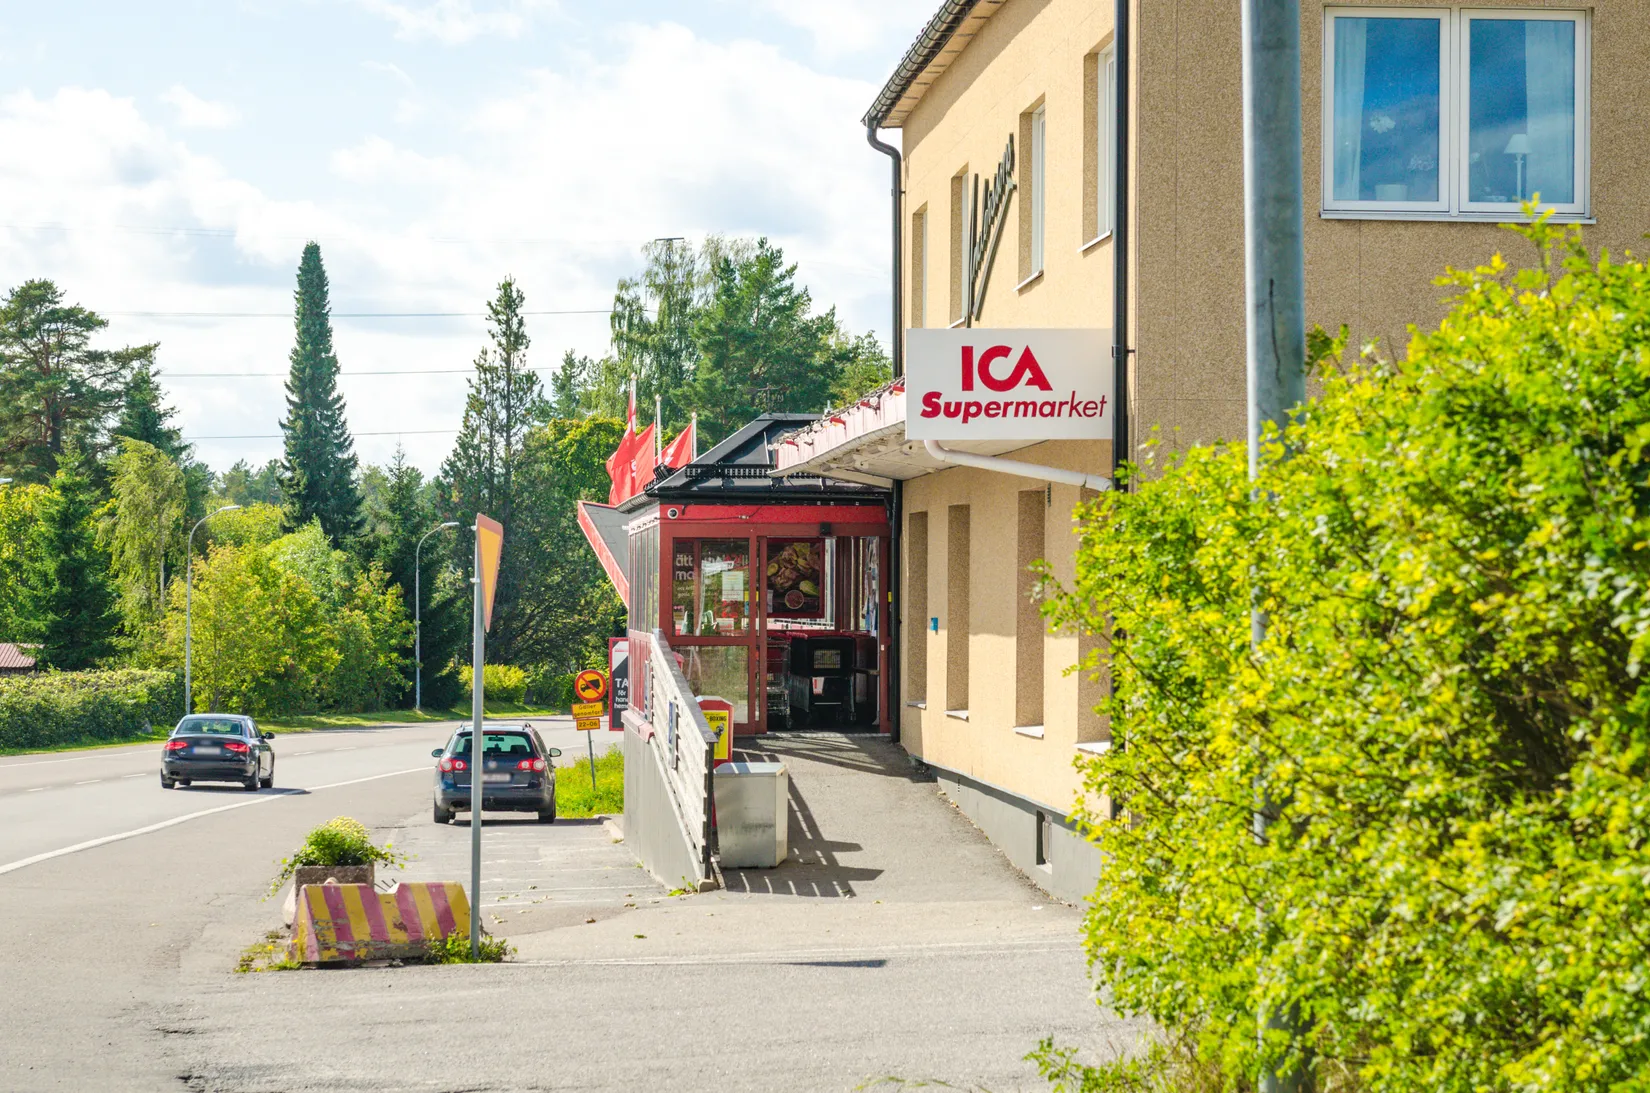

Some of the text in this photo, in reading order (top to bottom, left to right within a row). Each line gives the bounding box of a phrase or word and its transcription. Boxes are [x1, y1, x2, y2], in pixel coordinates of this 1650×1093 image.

[962, 344, 1054, 393] ICA
[920, 390, 1108, 424] Supermarket
[578, 720, 598, 728] 22-06
